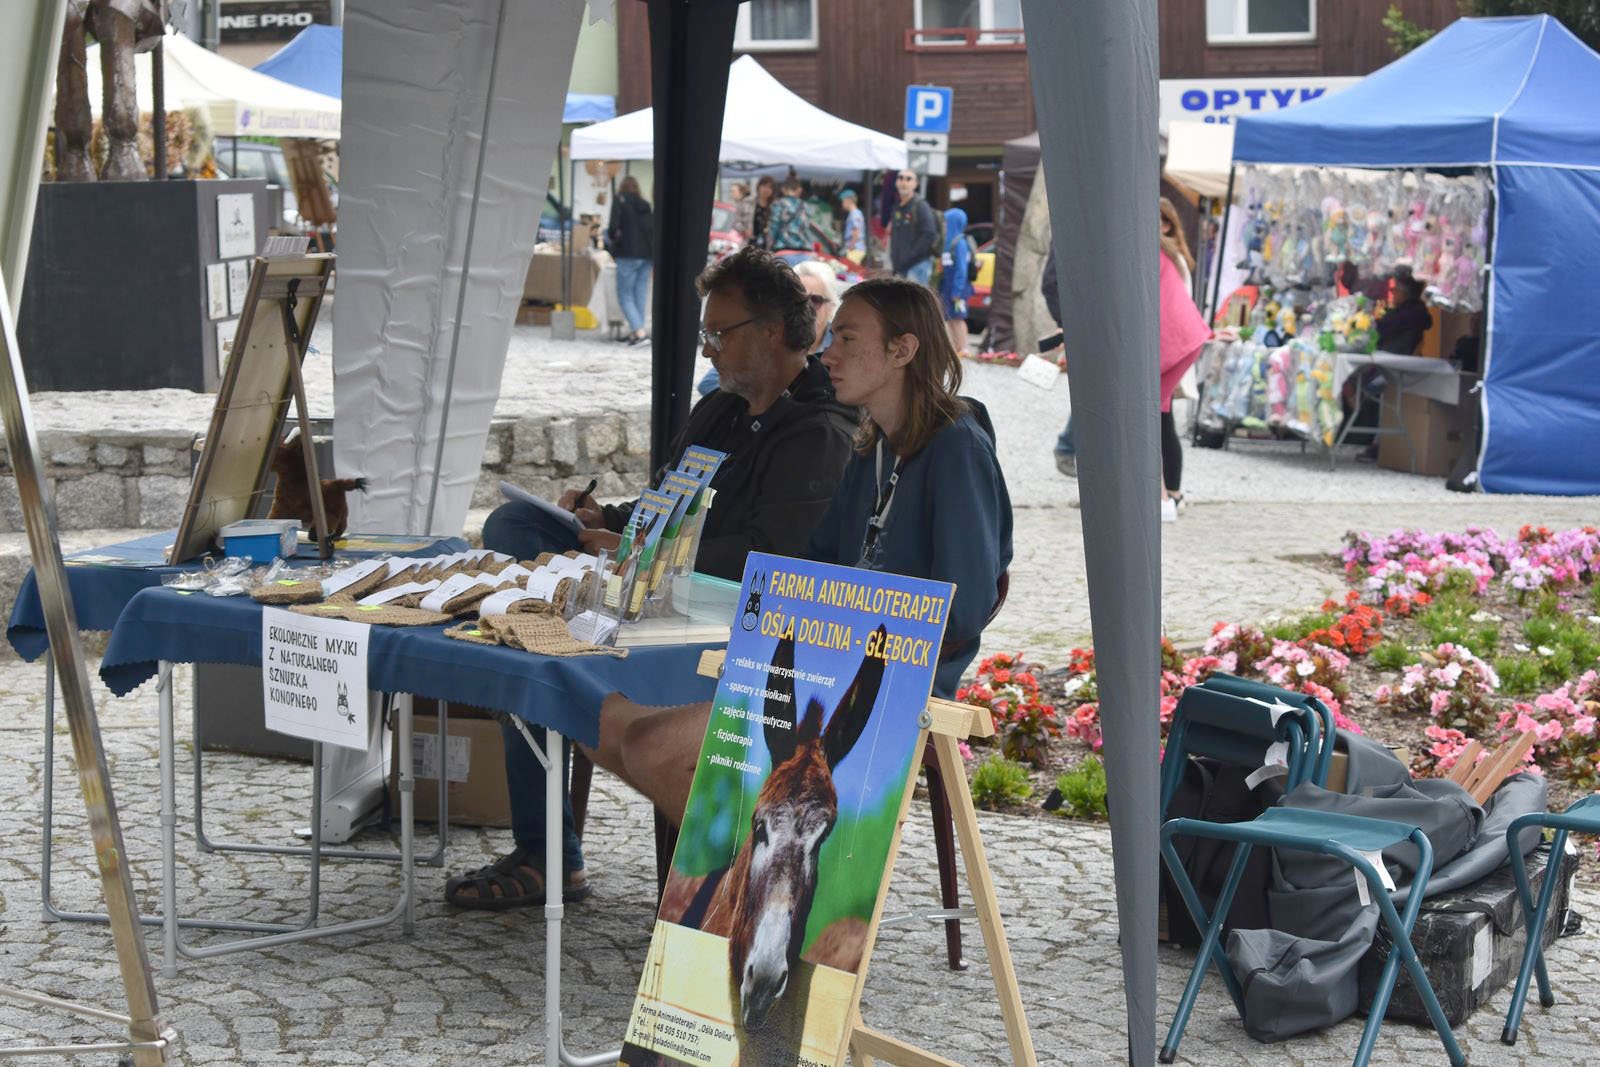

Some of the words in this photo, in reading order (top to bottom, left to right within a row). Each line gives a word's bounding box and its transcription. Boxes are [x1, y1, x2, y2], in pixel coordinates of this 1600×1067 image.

[260, 12, 313, 27] PRO
[915, 90, 944, 127] P
[769, 570, 814, 602] FARMA
[817, 579, 945, 624] ANIMALOTERAPII
[269, 626, 318, 650] EKOLOGICZNE
[325, 638, 358, 656] MYJKI
[761, 604, 795, 641] OŚLA
[798, 617, 852, 651] DOLINA
[865, 630, 933, 668] GŁĘBOCK
[268, 647, 275, 661] Z
[280, 649, 338, 674] NATURALNEGO
[735, 657, 755, 670] relaks
[763, 664, 806, 680] towarzystwie
[806, 672, 836, 688] zwierząt
[269, 667, 308, 689] SZNURKA
[269, 687, 318, 711] KONOPNEGO
[729, 681, 754, 697] spacery
[760, 688, 792, 704] osiołkami
[723, 704, 745, 719] zajęcia
[746, 711, 792, 730] terapeutyczne
[717, 728, 753, 747] fizjoterapia
[710, 754, 733, 768] pikniki
[733, 760, 761, 775] rodzinne
[640, 1004, 657, 1016] Farma
[657, 1009, 697, 1030] Animaloterapii
[664, 1025, 675, 1037] 505
[676, 1029, 687, 1040] 510
